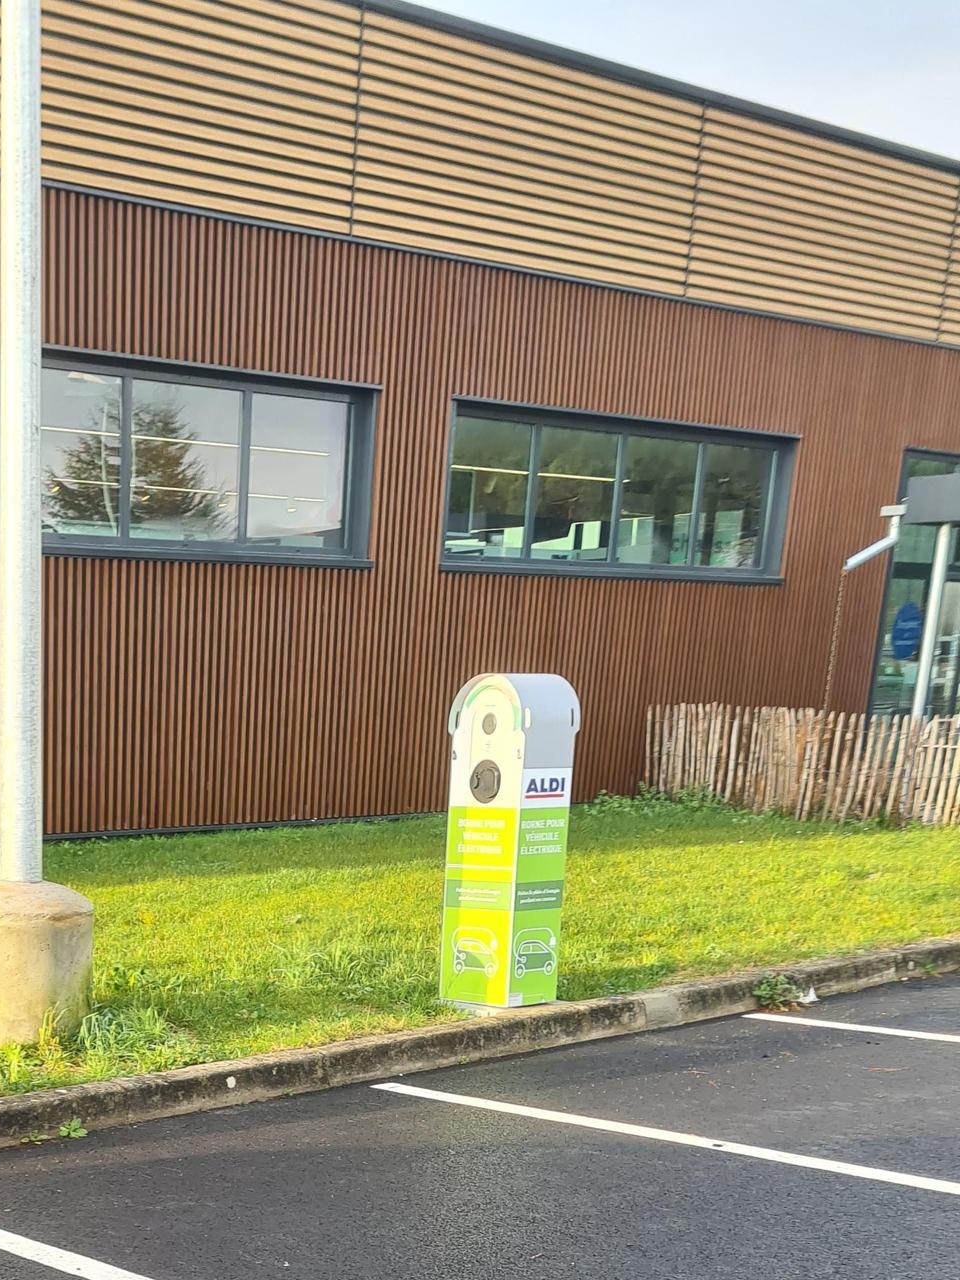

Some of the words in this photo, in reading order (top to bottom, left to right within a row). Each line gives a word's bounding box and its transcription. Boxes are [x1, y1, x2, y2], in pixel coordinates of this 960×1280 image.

[526, 777, 565, 793] ALDI
[546, 818, 565, 828] POUR
[526, 830, 560, 841] VÉHICULE
